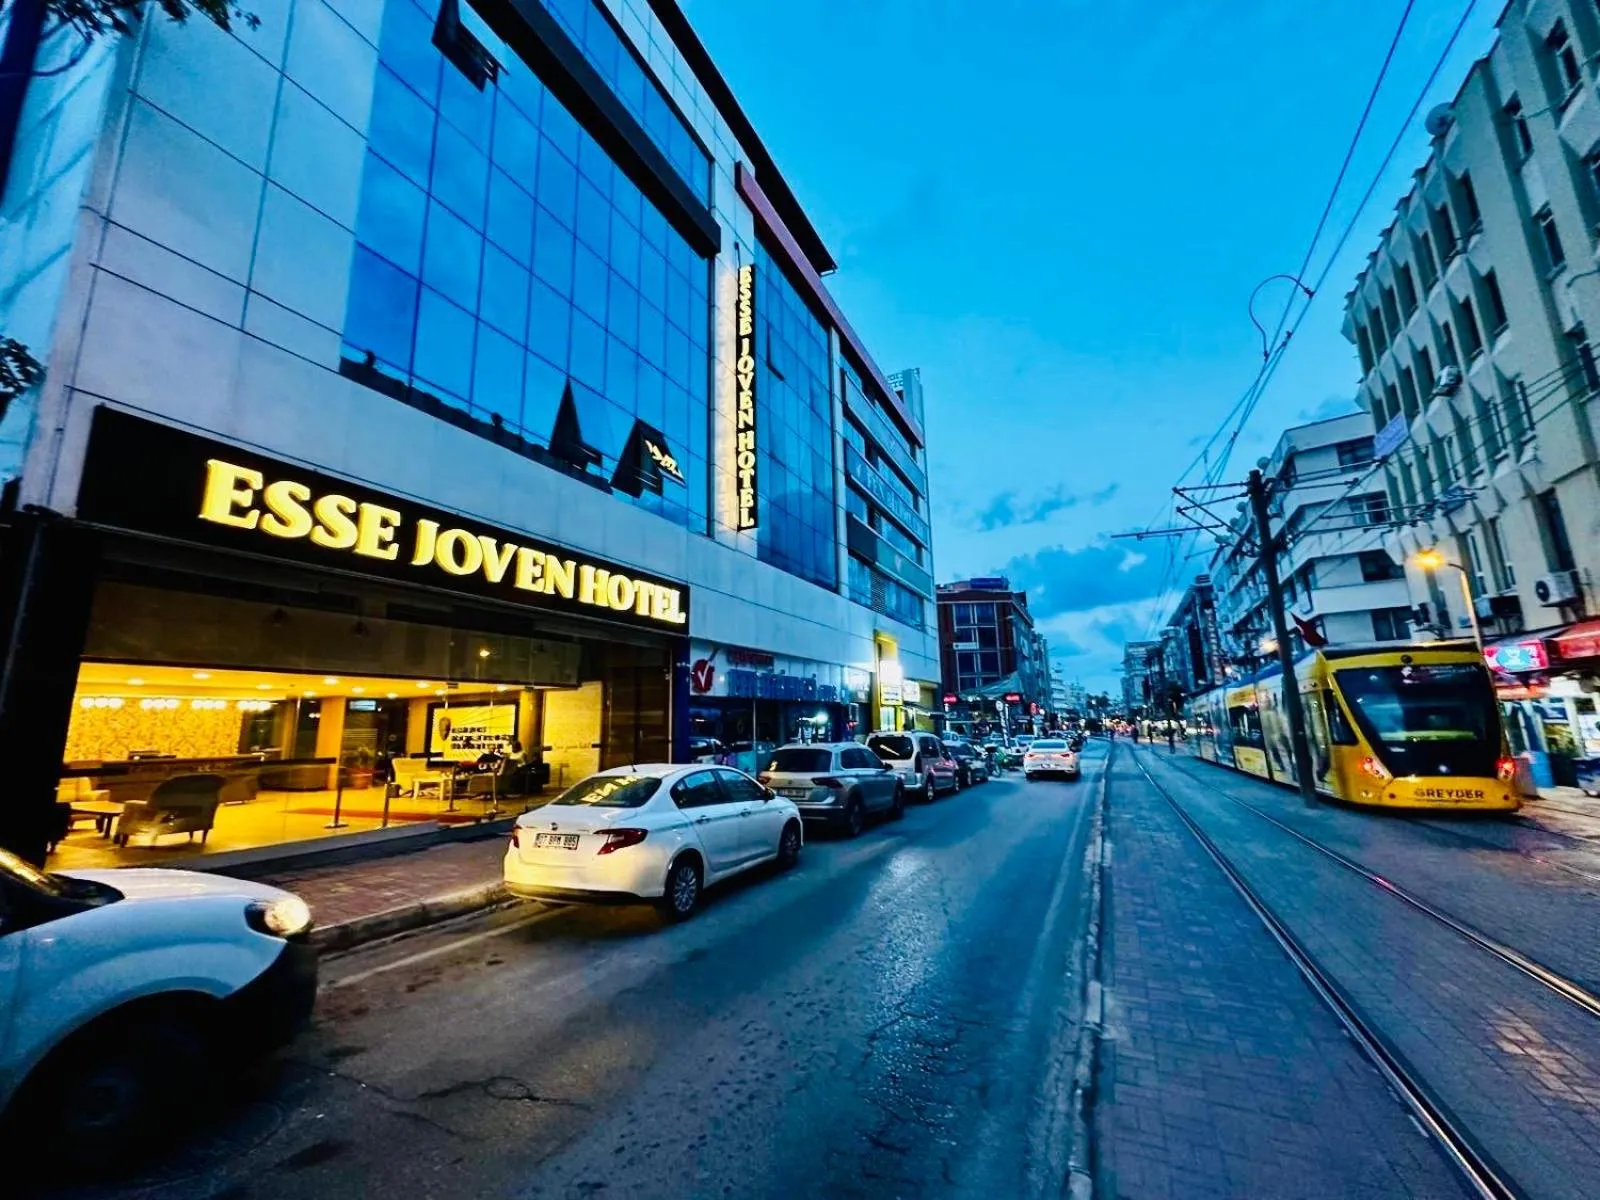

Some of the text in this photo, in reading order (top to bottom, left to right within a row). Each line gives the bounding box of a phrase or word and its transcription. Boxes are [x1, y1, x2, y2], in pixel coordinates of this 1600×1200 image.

[737, 337, 755, 429] JOVEN
[737, 430, 756, 528] HOTEL
[198, 458, 687, 624] ESSE JOVEN HOTEL
